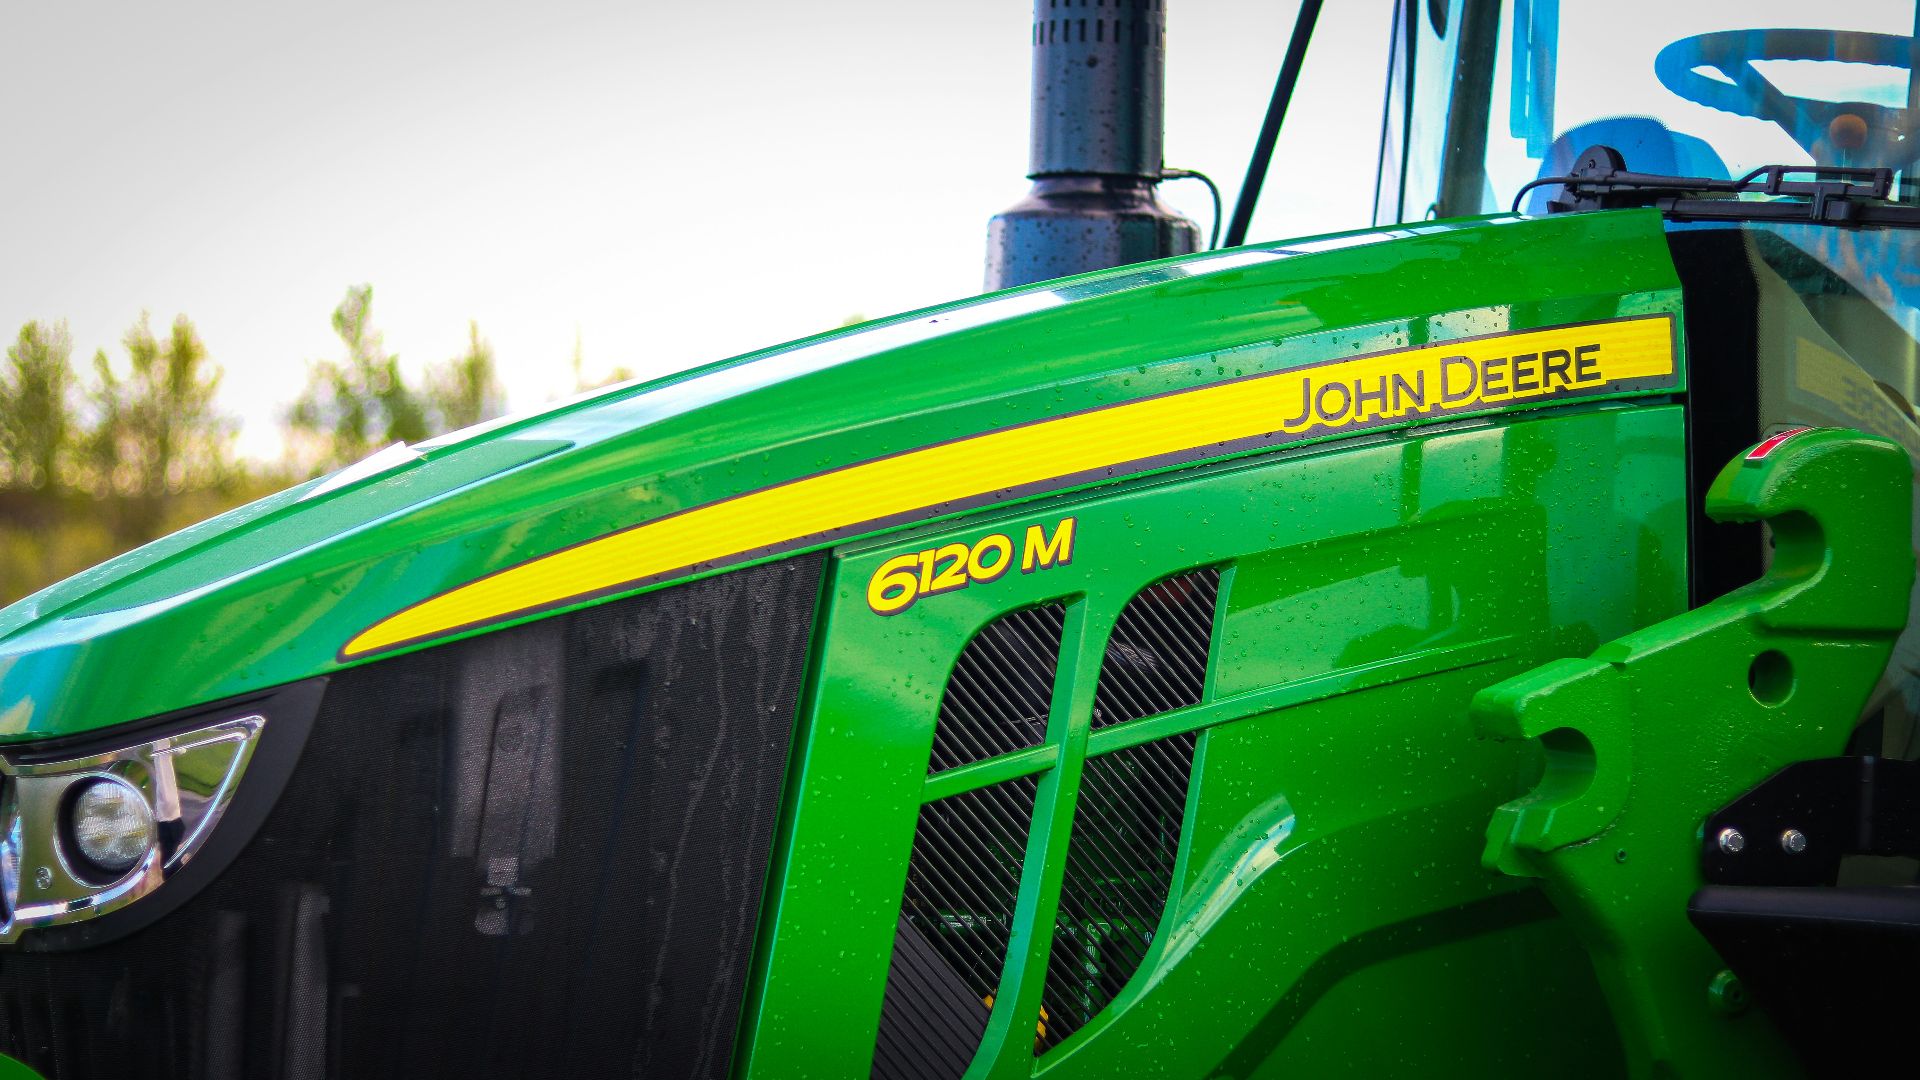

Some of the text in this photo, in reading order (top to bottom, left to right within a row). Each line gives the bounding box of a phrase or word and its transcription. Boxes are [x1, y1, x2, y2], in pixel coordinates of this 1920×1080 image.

[1284, 343, 1602, 428] JOHN DEERE
[867, 516, 1077, 616] 6120 M
